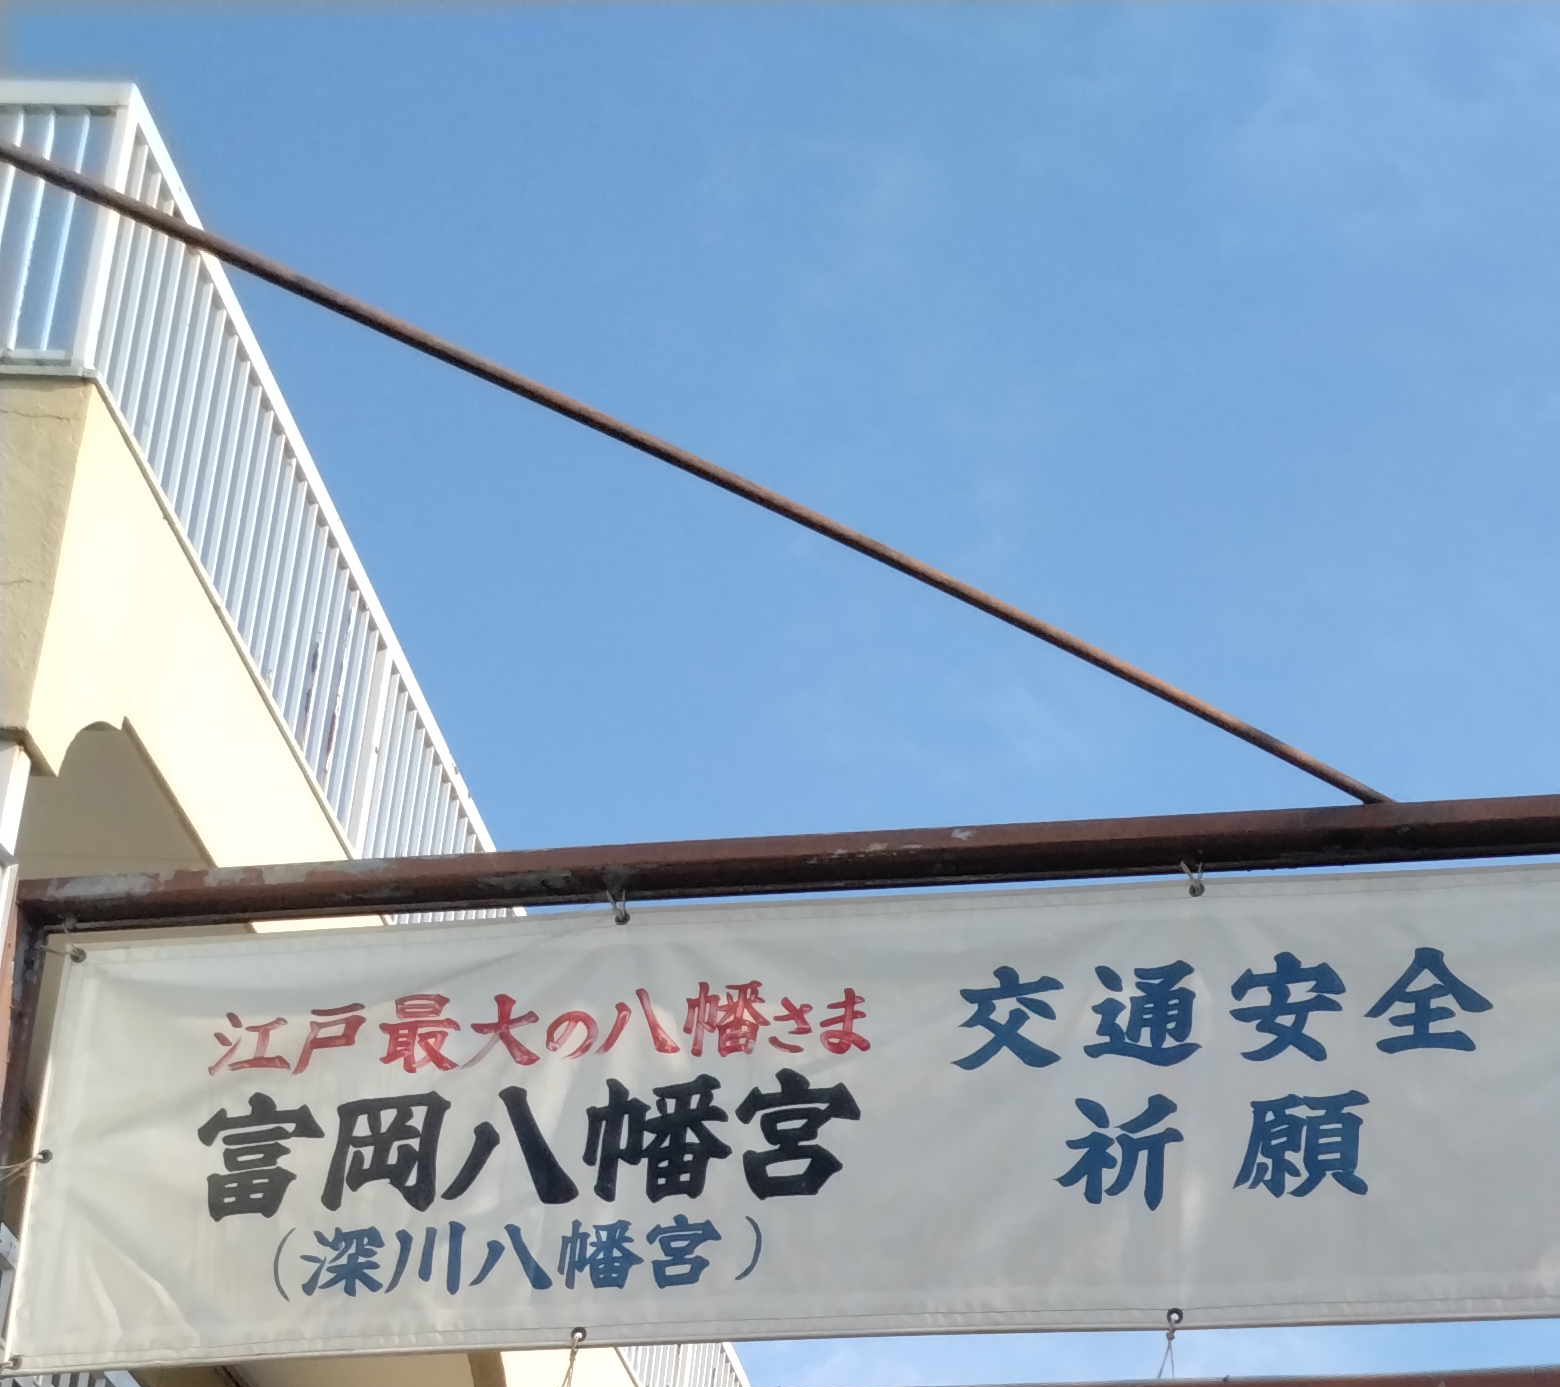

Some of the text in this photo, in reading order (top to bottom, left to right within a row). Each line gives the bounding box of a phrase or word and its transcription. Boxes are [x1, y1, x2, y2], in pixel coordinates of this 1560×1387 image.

[207, 978, 872, 1077] 江戸最大の八幡さま
[951, 946, 1494, 1071] 交通安全
[197, 1068, 862, 1222] 富岡八幡宮
[1053, 1089, 1370, 1212] 祈願
[272, 1213, 763, 1303] （深川八幡宮）
